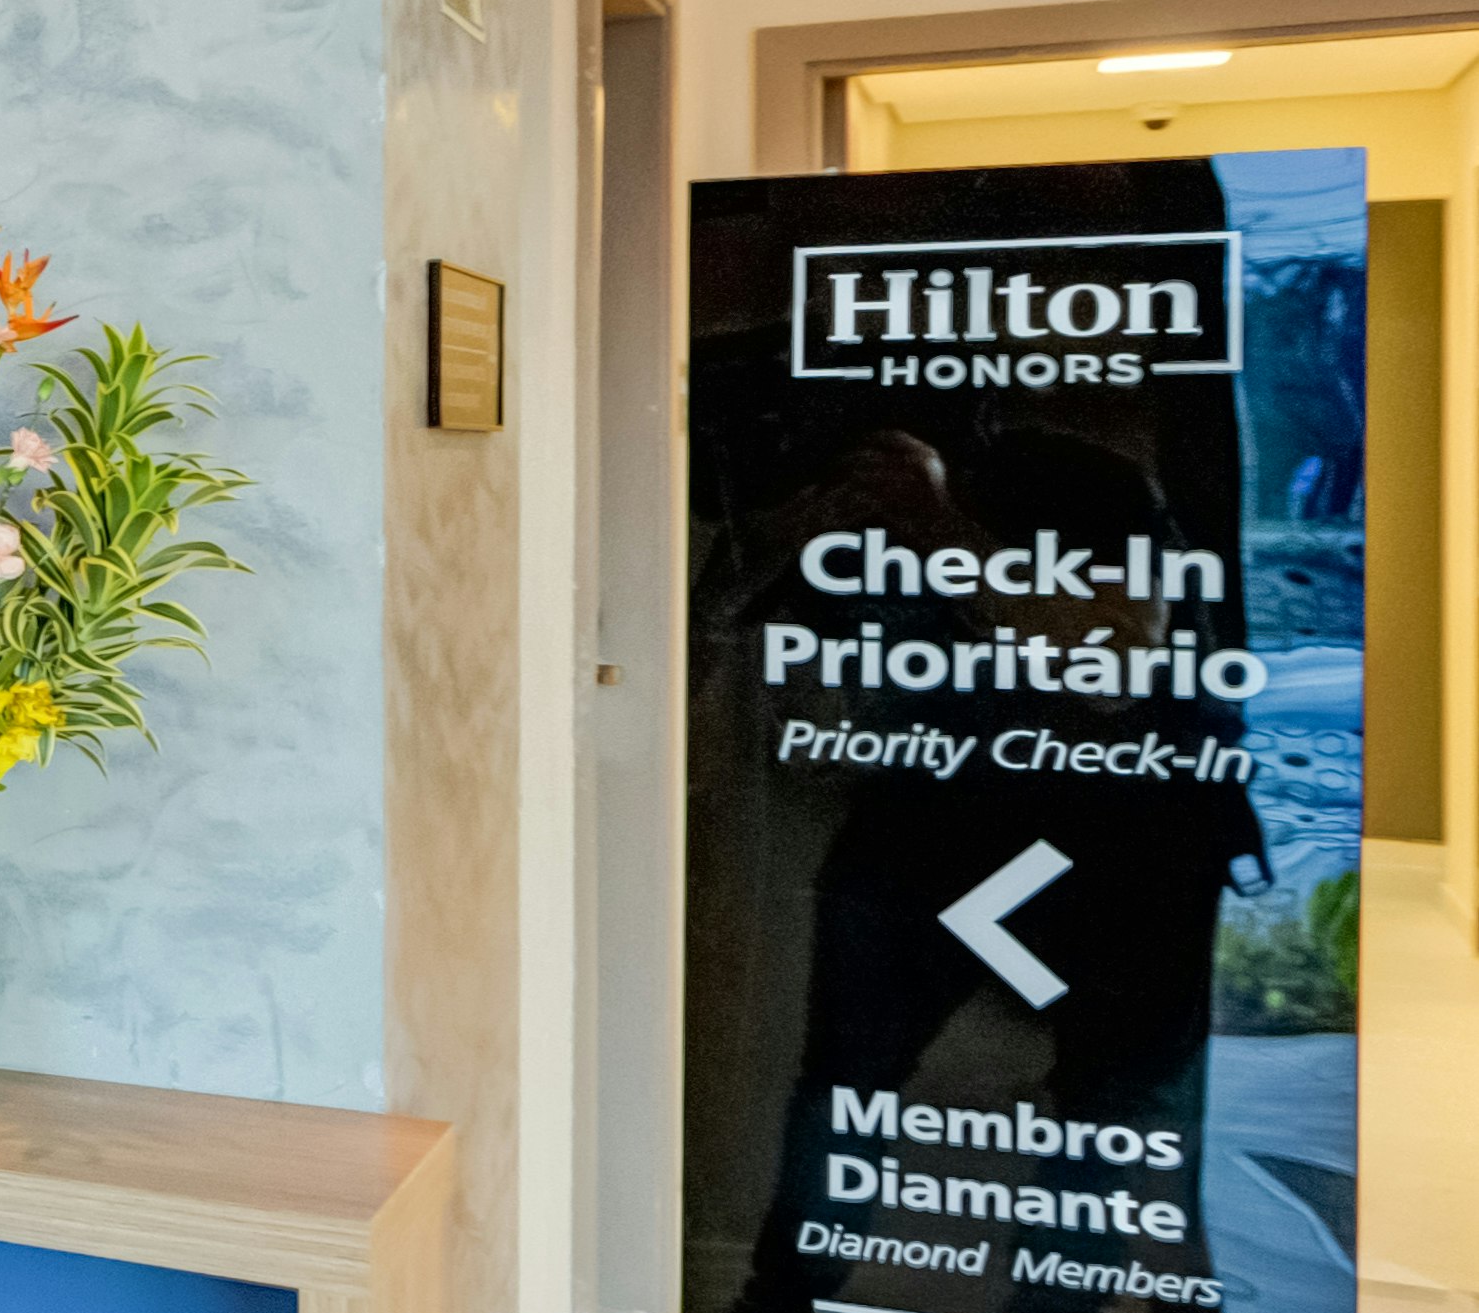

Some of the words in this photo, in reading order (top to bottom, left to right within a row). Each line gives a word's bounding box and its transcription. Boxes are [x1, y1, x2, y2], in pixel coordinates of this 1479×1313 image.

[827, 268, 1203, 345] Hilton
[880, 353, 1146, 389] HONORS
[801, 528, 1224, 601] Check-In
[763, 624, 1268, 702] Prioritário
[778, 721, 976, 780] Priority
[991, 728, 1252, 782] Check-In
[830, 1085, 1184, 1168] Membros
[826, 1154, 1188, 1241] Diamante
[796, 1221, 989, 1277] Diamond
[1011, 1250, 1224, 1307] Members
